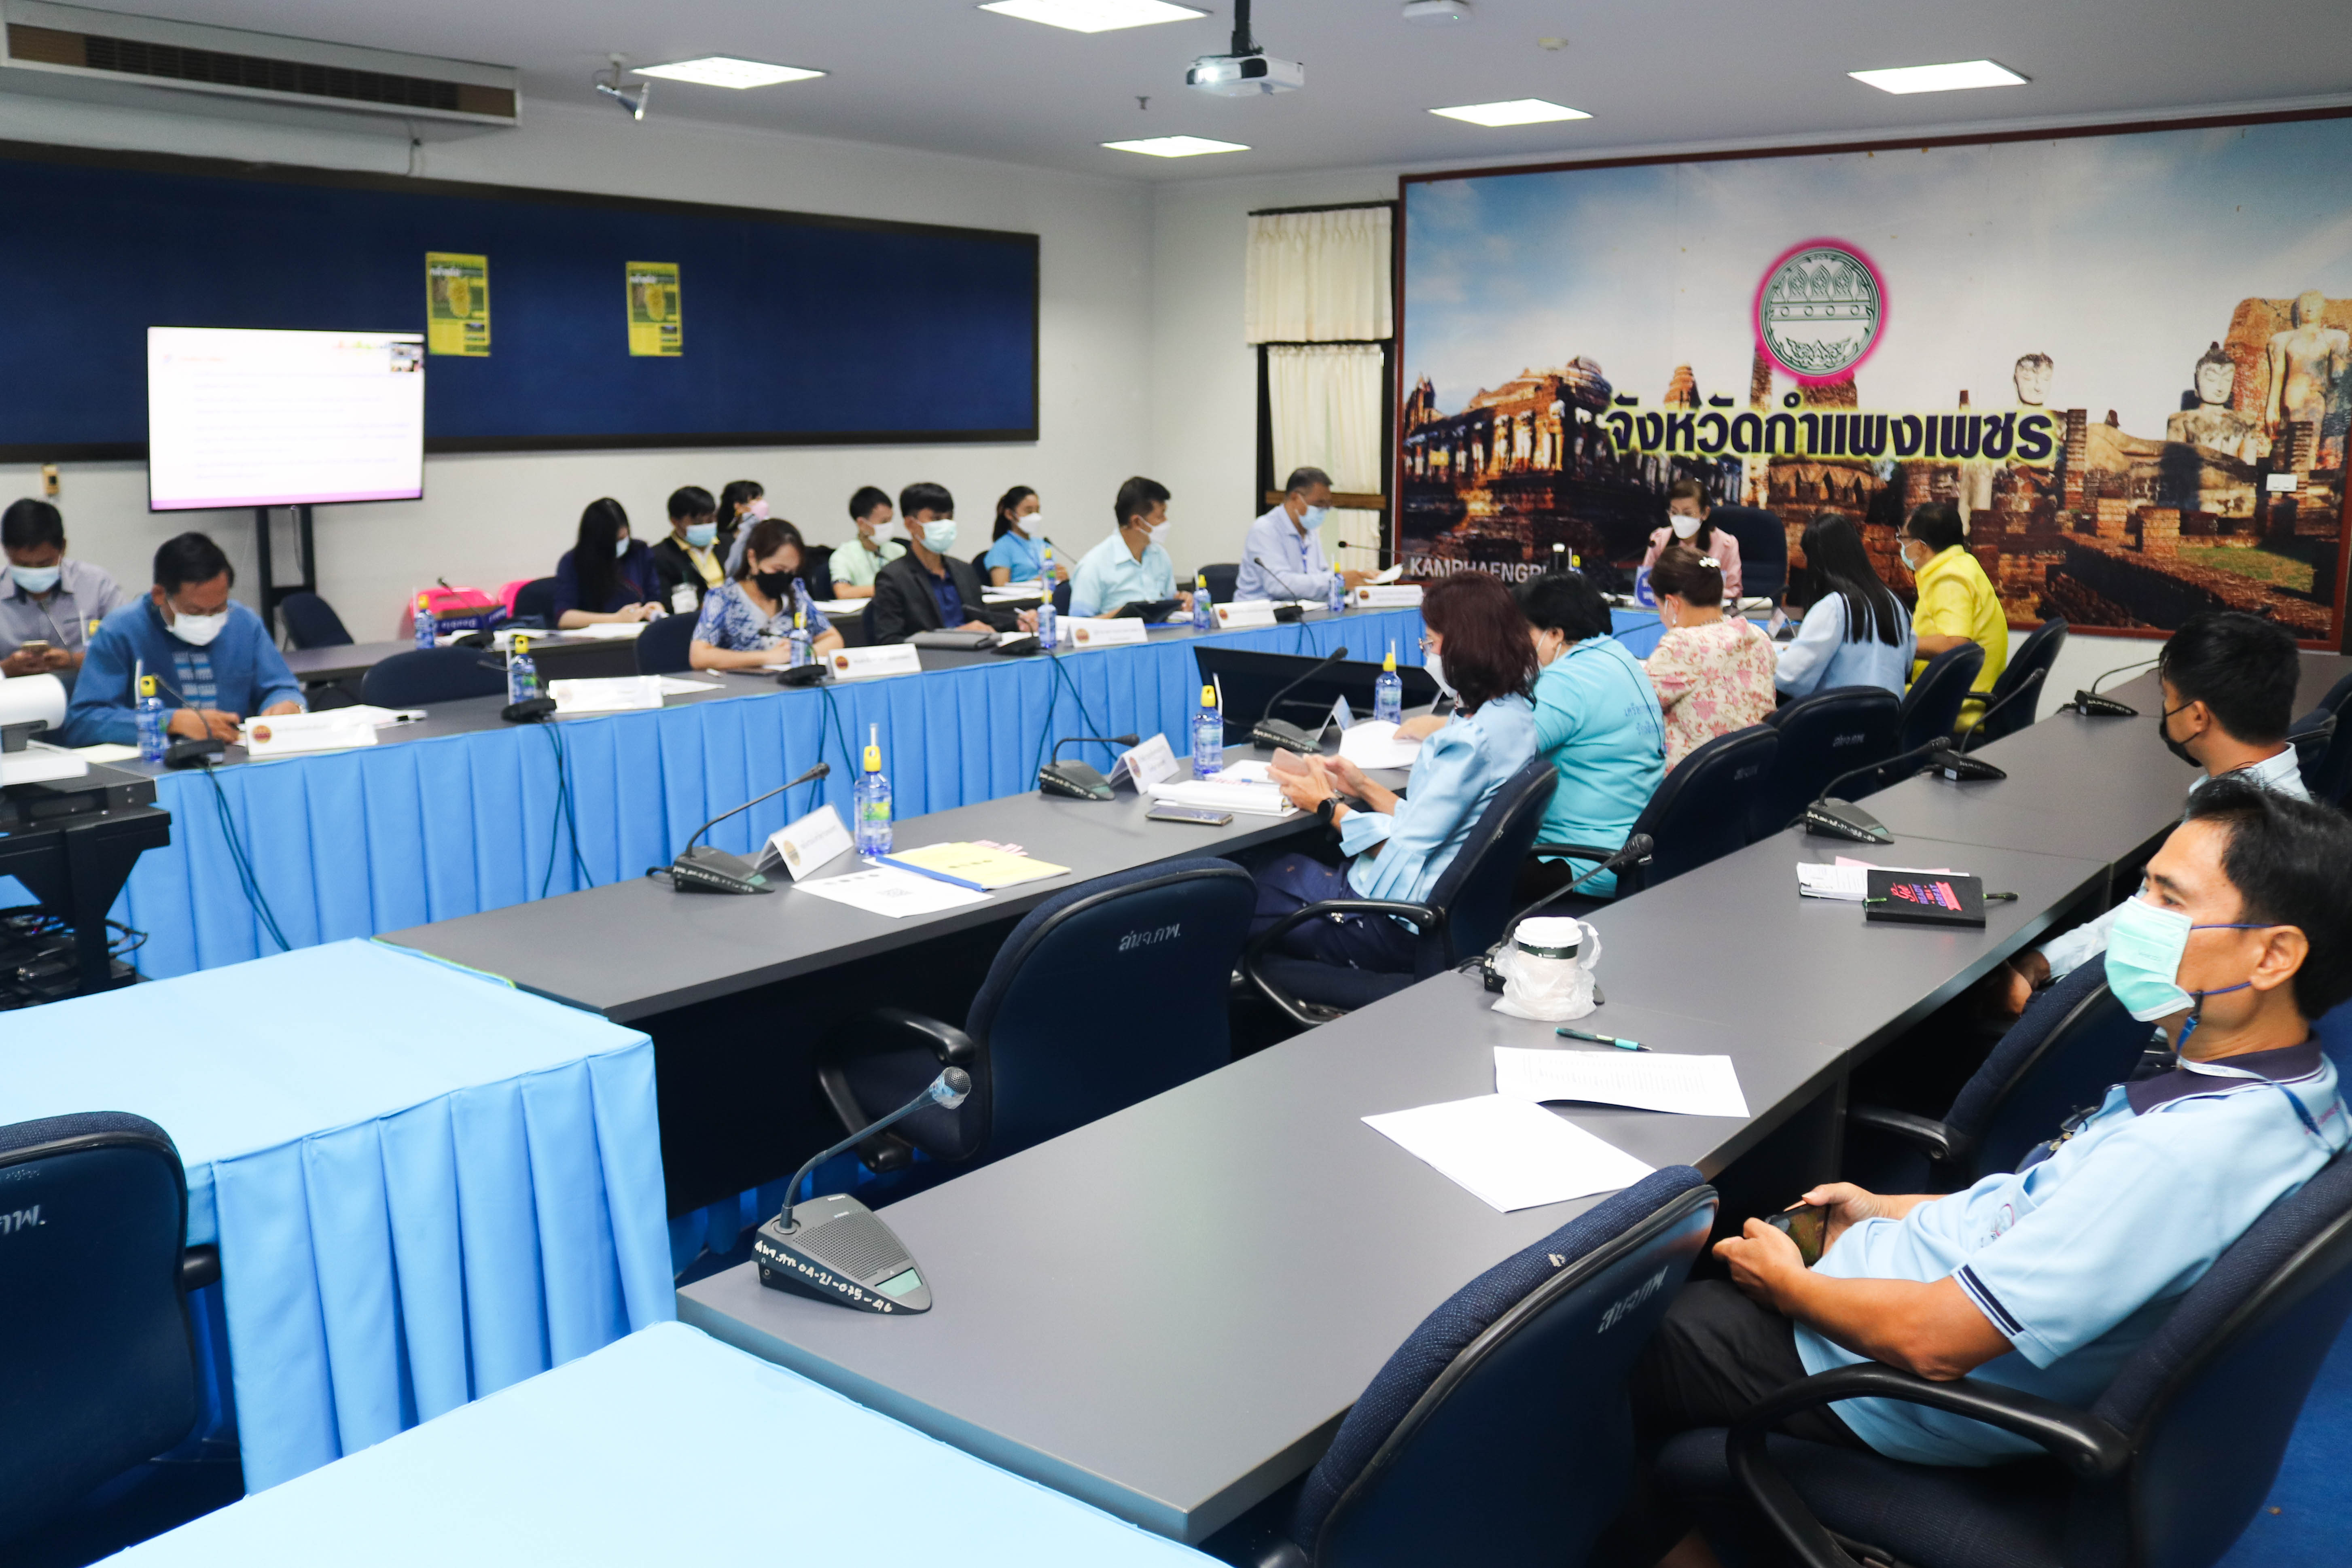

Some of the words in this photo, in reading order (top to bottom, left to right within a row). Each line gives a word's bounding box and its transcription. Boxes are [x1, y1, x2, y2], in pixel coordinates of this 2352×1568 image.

[1605, 391, 2053, 460] จังหวัดกำแพงเพชร
[1929, 884, 1947, 907] GREAT
